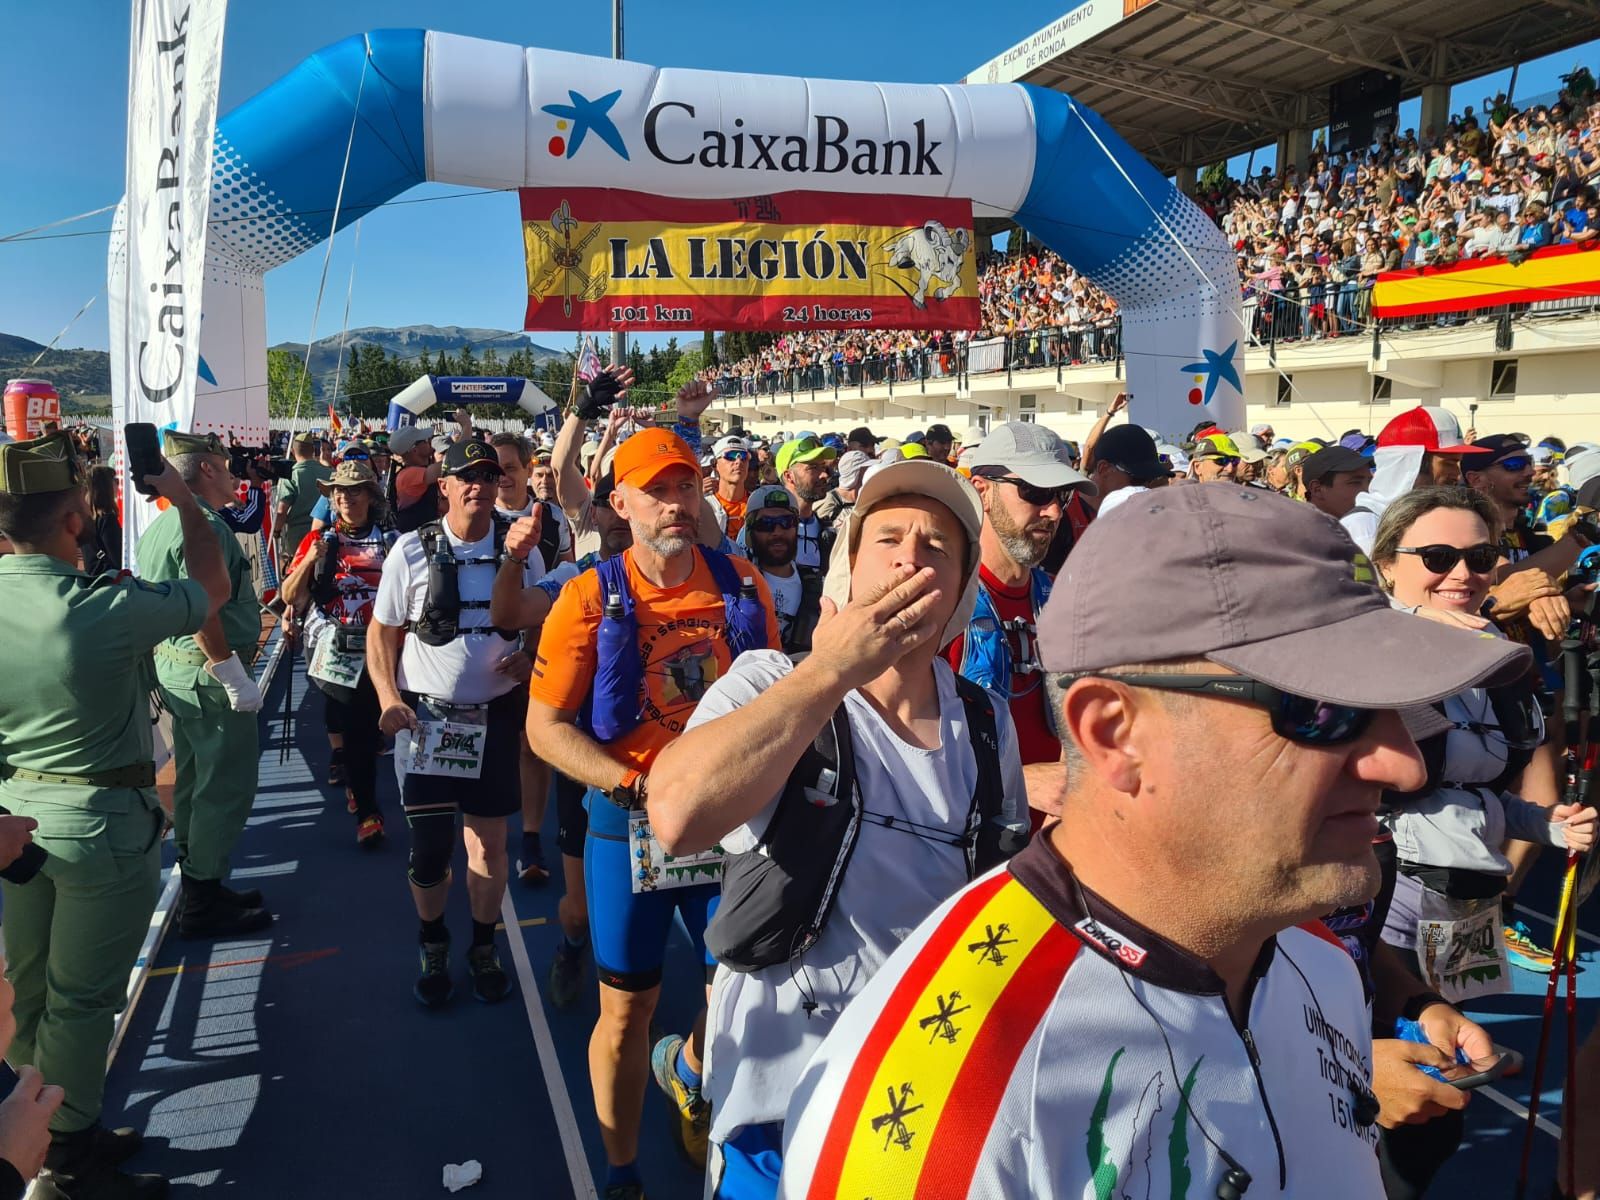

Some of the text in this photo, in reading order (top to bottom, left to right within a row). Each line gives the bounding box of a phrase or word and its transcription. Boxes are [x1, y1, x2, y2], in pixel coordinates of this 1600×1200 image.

[1032, 4, 1094, 49] AYUNTAMIENTO
[1026, 38, 1066, 69] DE RONDA
[1332, 121, 1350, 132] LOCAL
[643, 101, 943, 176] CaixaBank
[138, 4, 190, 403] CaixaBank
[608, 230, 868, 281] LA LEGIÓN
[611, 304, 694, 322] 101 km
[783, 304, 873, 322] 24 horas
[461, 383, 505, 392] INTERSPORT
[27, 397, 61, 418] BC
[656, 617, 711, 637] SERGIO
[441, 731, 475, 752] 674
[1316, 1047, 1344, 1090] Trail
